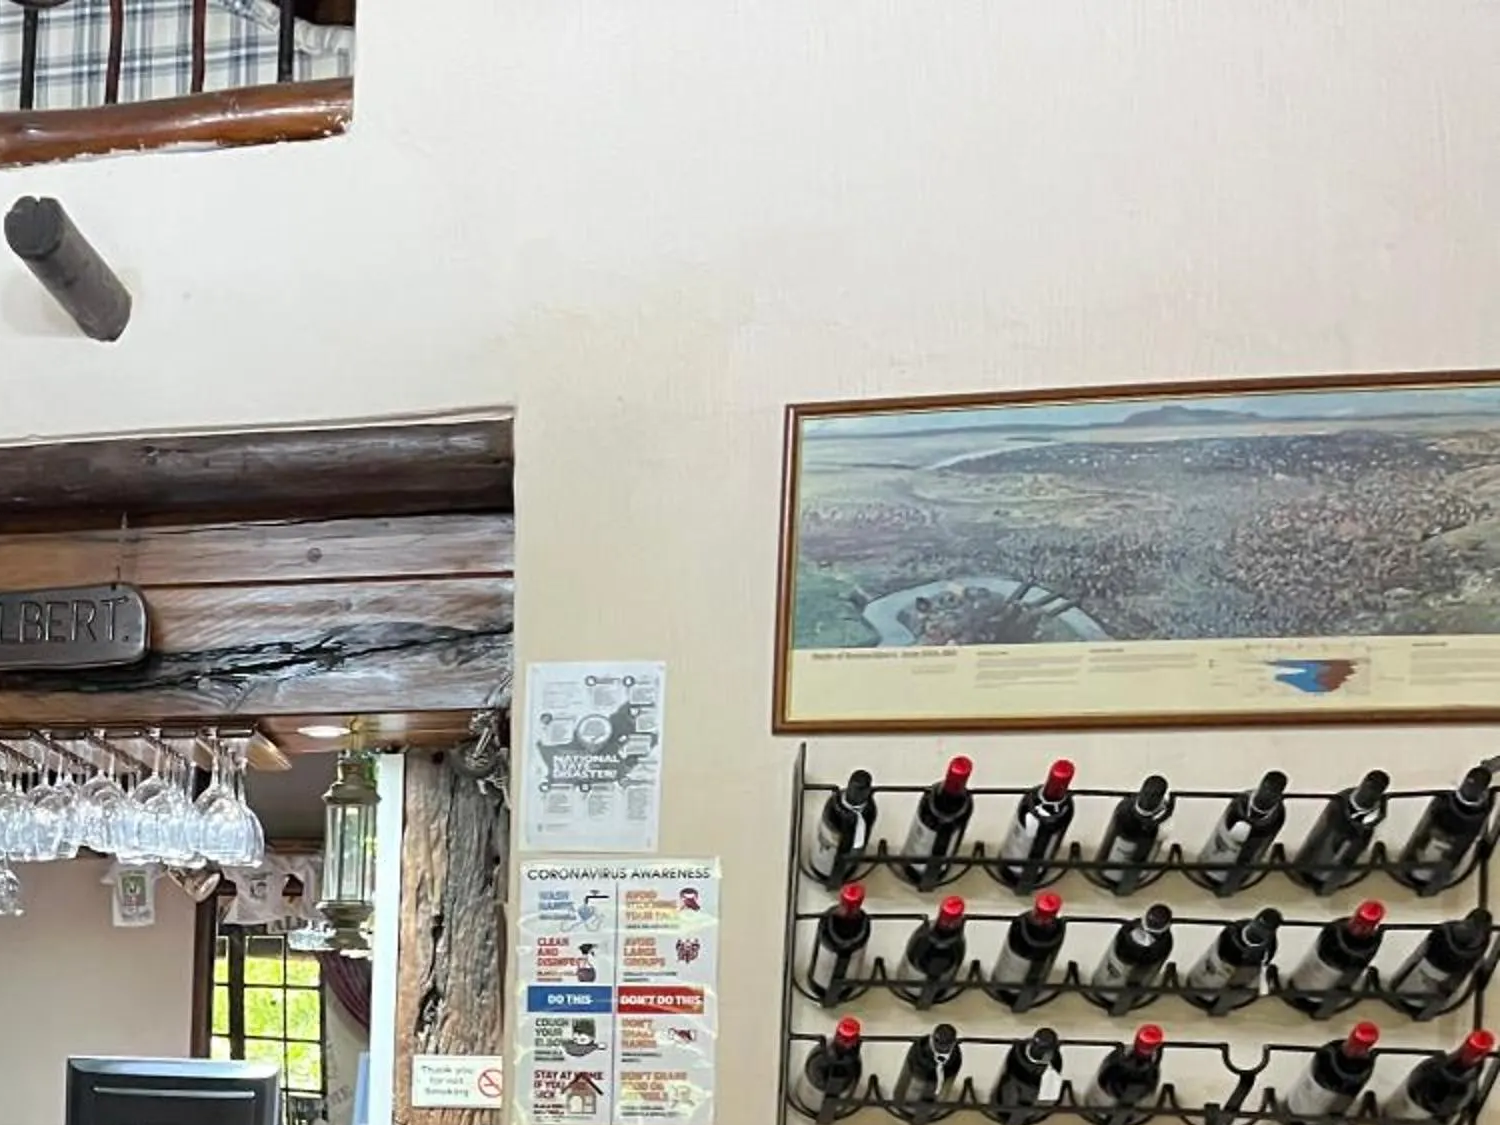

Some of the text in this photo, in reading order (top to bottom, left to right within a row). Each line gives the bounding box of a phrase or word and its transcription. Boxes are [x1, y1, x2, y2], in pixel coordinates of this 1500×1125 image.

[552, 755, 621, 764] NATIONAL
[528, 867, 712, 880] CORONAVIRUS AWARENESS
[537, 937, 570, 946] CLEAN
[537, 947, 558, 957] AND
[547, 995, 592, 1005] DO THIS
[620, 995, 701, 1005] DON'T DO THIS
[535, 1018, 569, 1027] COUGH
[535, 1028, 563, 1037] YOUR
[534, 1070, 558, 1080] STAY
[560, 1070, 573, 1080] AT
[534, 1081, 542, 1090] IF
